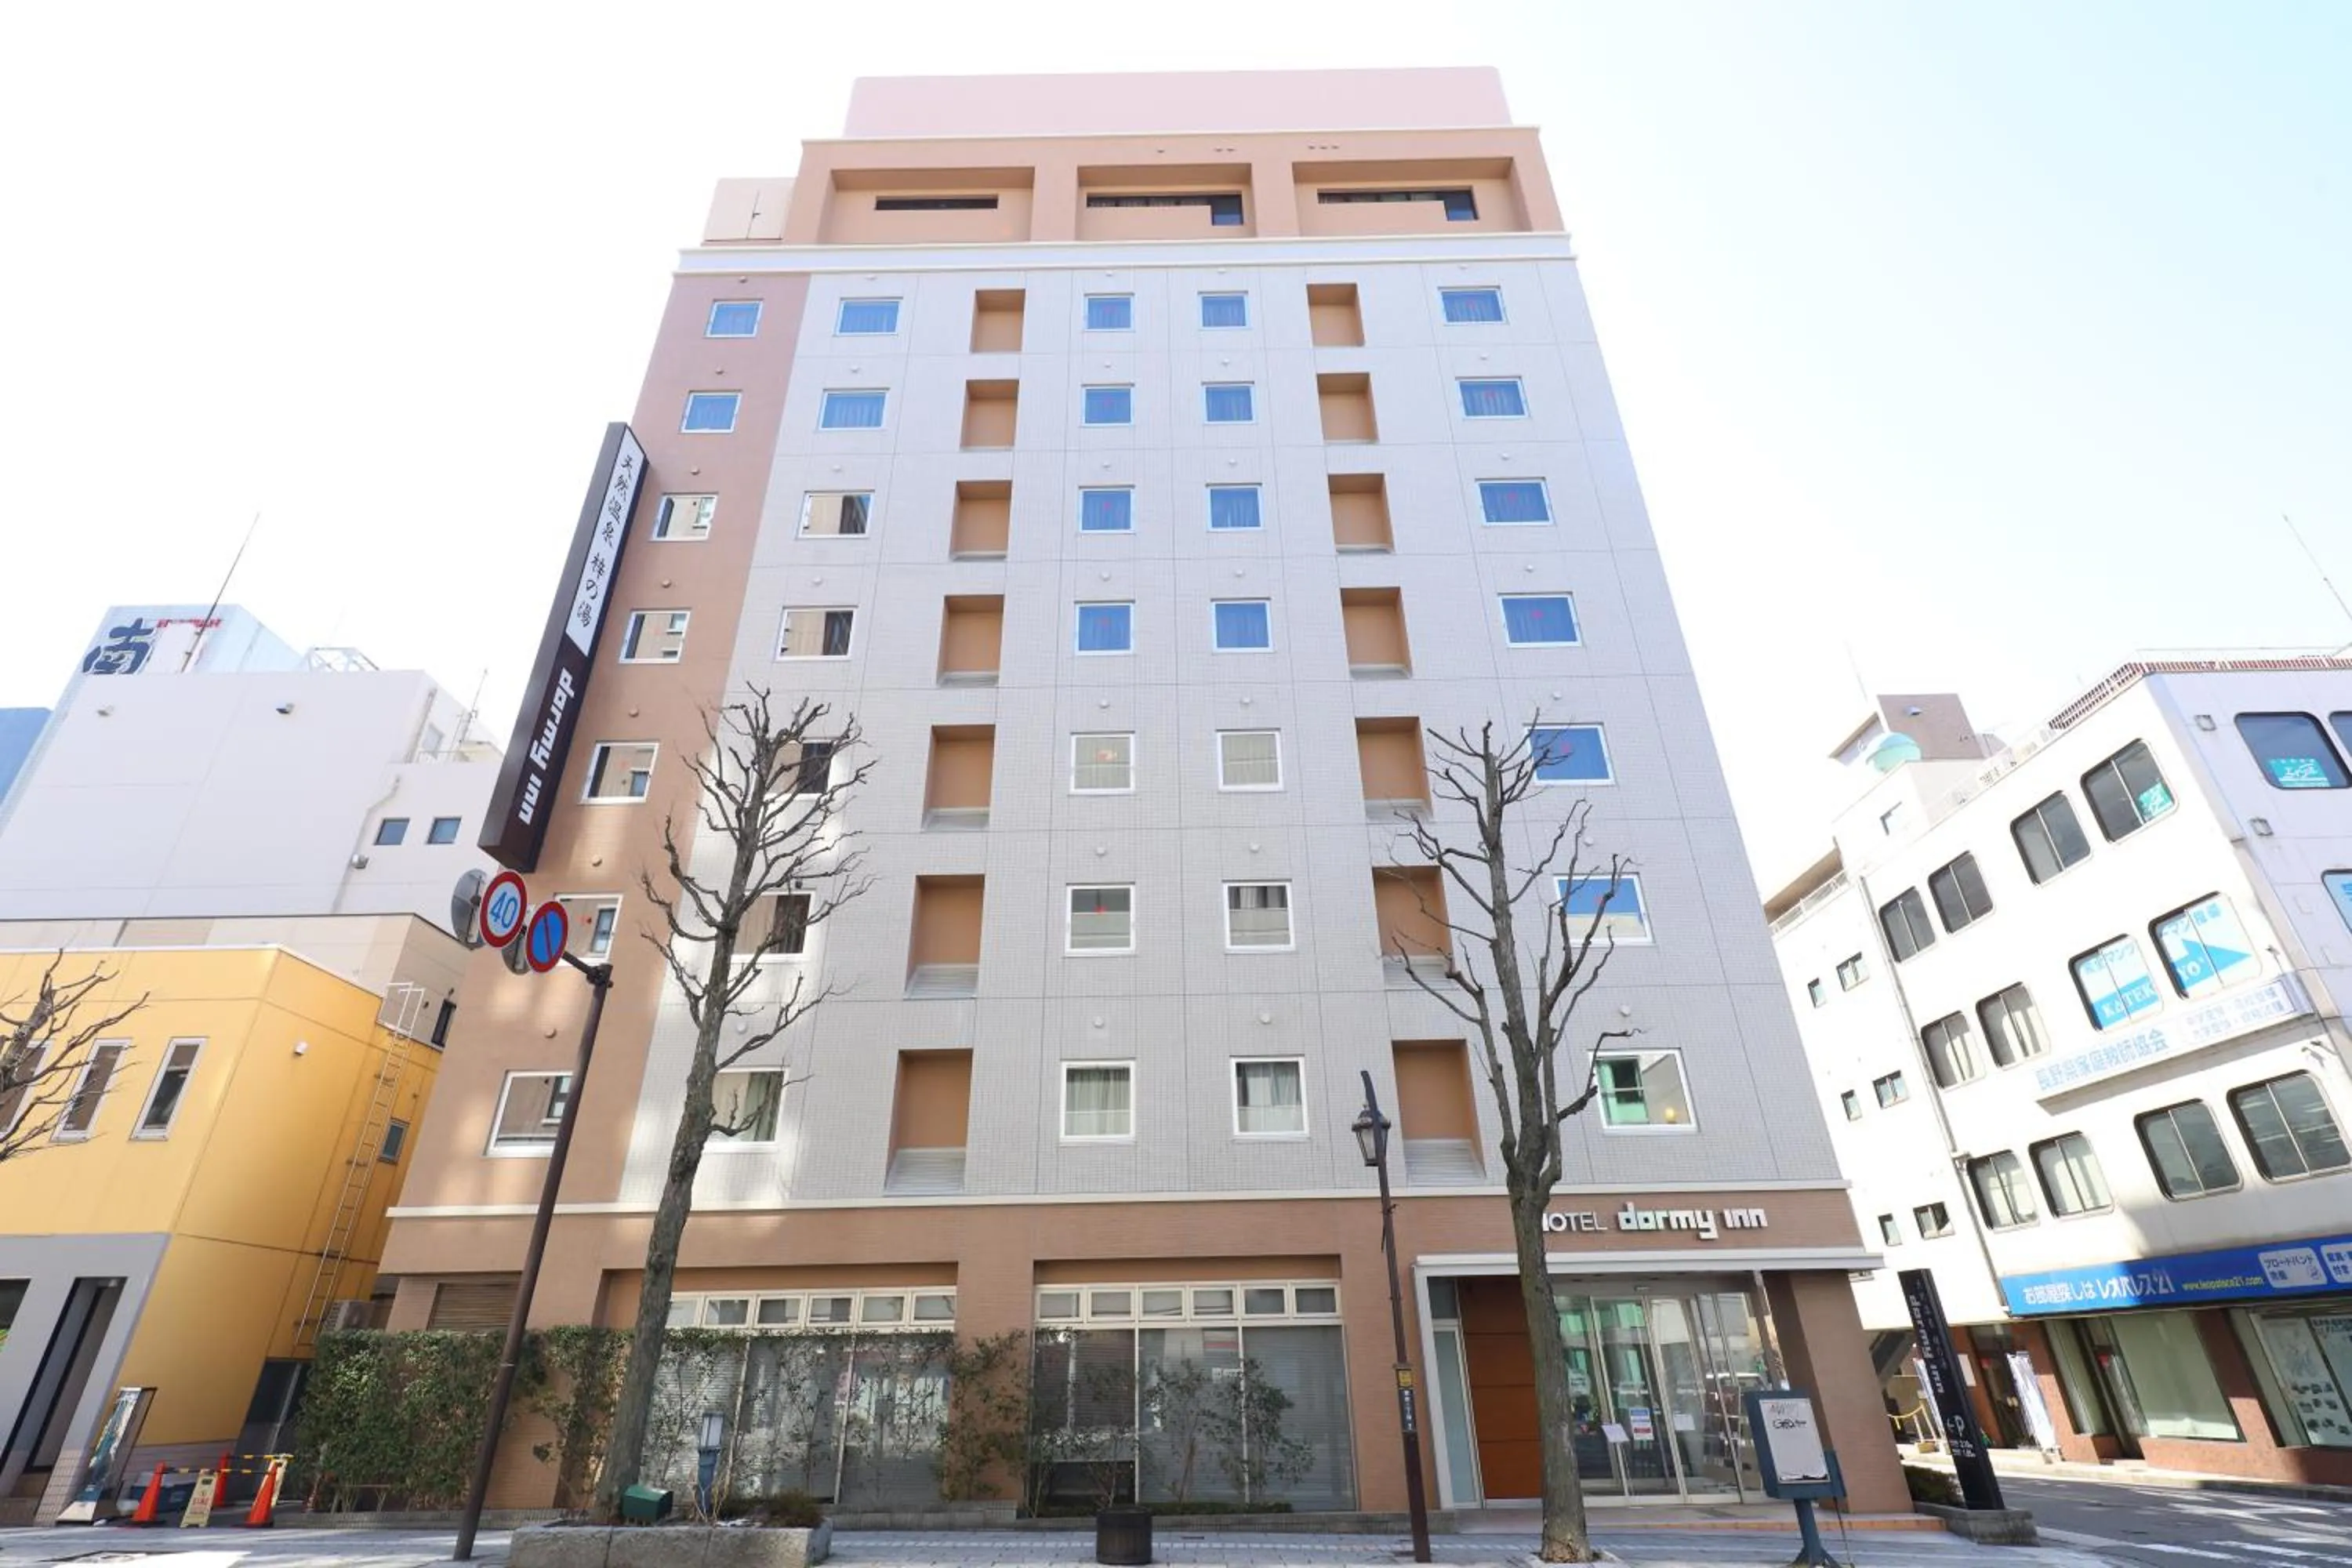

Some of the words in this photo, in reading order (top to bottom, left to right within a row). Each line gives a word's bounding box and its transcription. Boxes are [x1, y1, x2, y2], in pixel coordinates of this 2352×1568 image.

[602, 455, 633, 548] 天然温泉
[529, 667, 575, 771] dormy
[518, 773, 542, 825] inn
[488, 891, 518, 929] 40
[1617, 1201, 1719, 1240] dormy
[1722, 1207, 1768, 1229] inn
